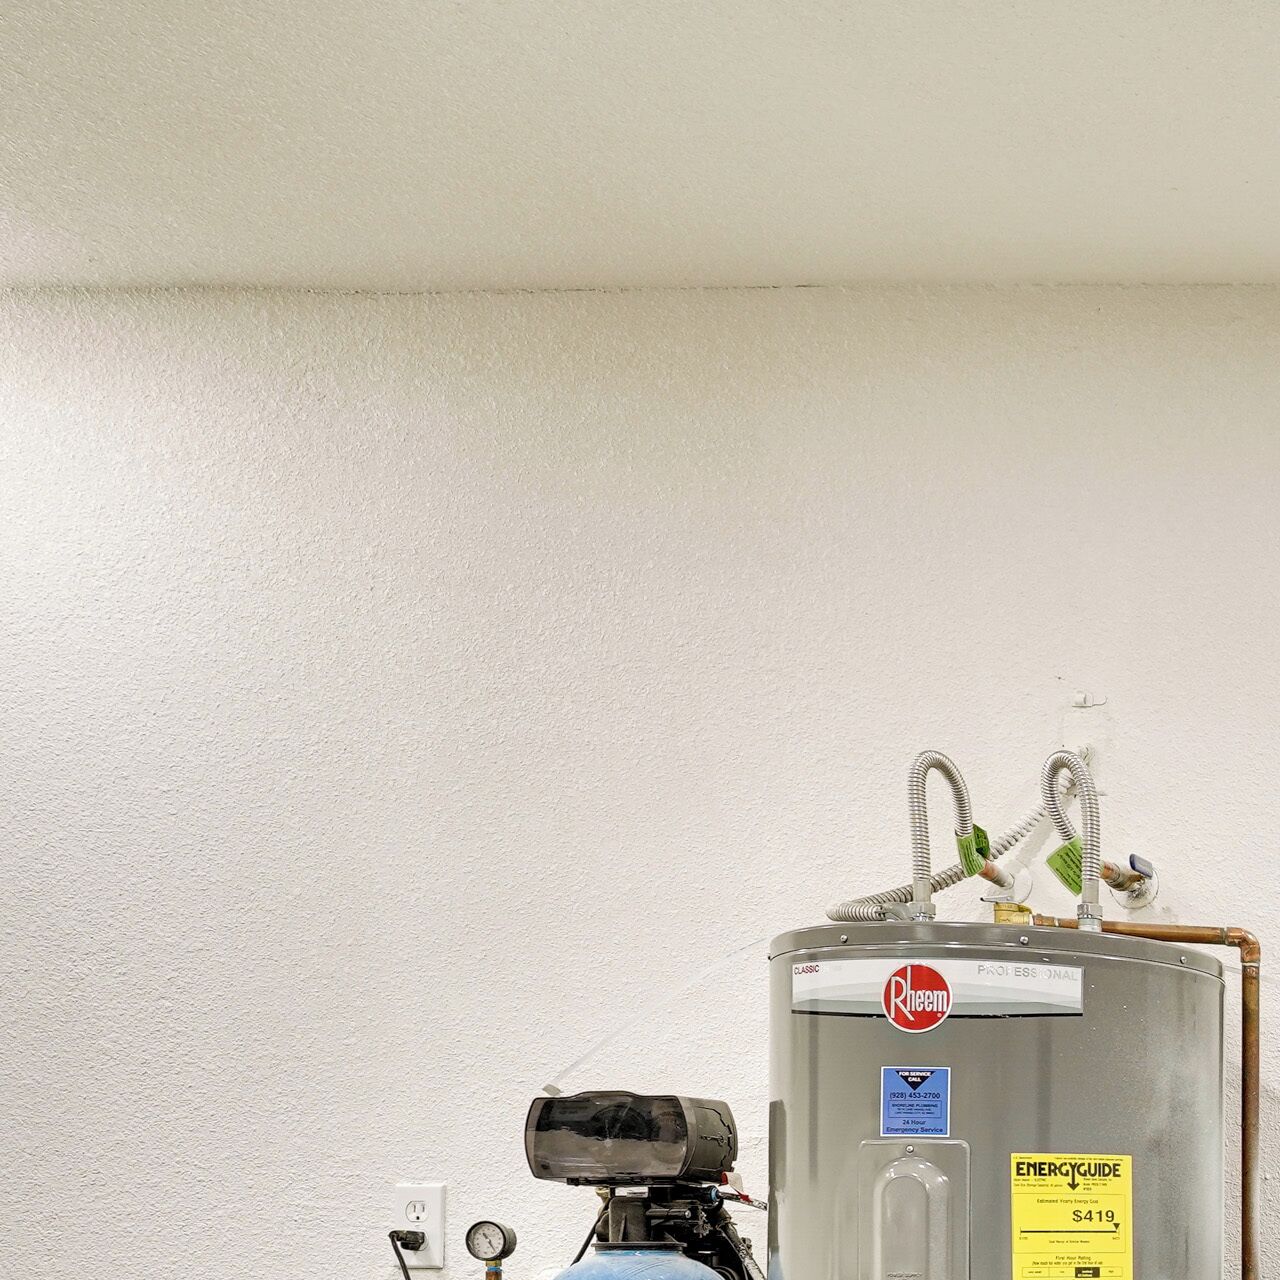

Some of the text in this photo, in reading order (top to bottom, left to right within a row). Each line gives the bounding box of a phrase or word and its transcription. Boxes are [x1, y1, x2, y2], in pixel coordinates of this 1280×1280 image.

[794, 965, 819, 975] CLASSIC
[890, 966, 948, 1021] Rheem
[1016, 1161, 1121, 1178] ENERGYGUIDE
[1072, 1209, 1115, 1223] $419
